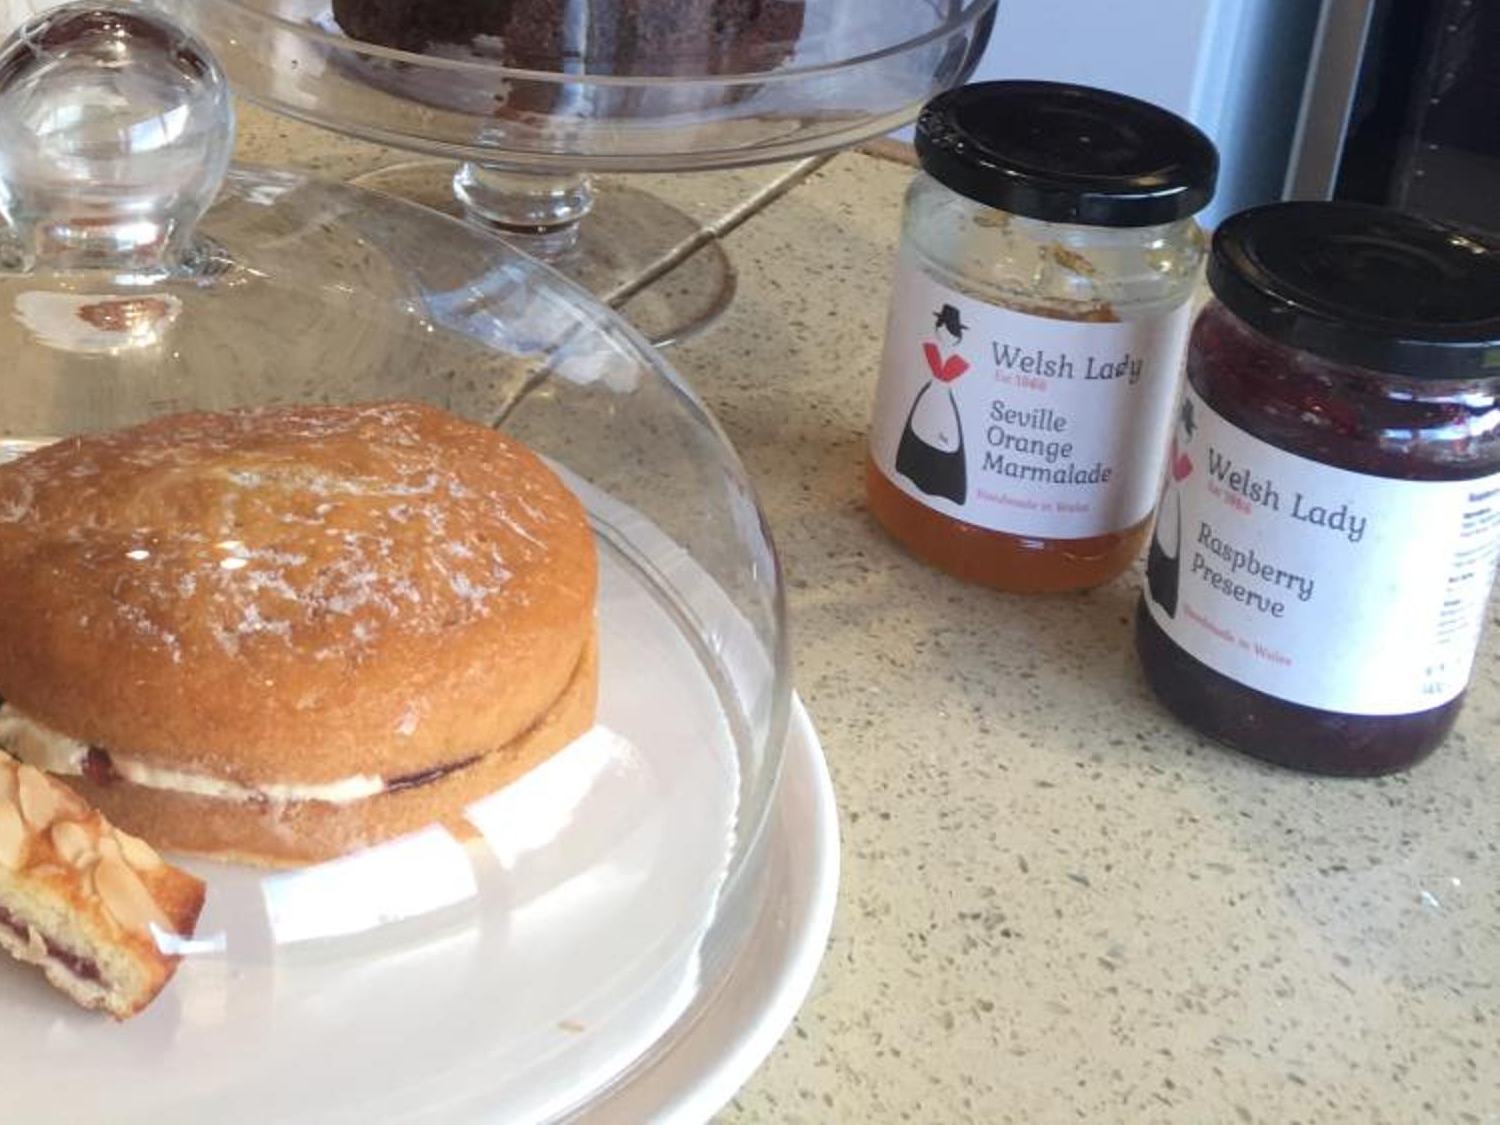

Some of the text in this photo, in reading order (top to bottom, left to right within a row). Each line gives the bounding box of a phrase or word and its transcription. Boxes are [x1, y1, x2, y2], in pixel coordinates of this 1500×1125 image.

[992, 341, 1143, 385] Welsh Lady
[990, 400, 1067, 432] Seville
[987, 426, 1073, 463] Orange
[982, 451, 1113, 485] Marmalade
[1207, 448, 1368, 543] Welsh Lady
[1197, 522, 1315, 602] Raspberry
[1191, 553, 1286, 618] Preserve
